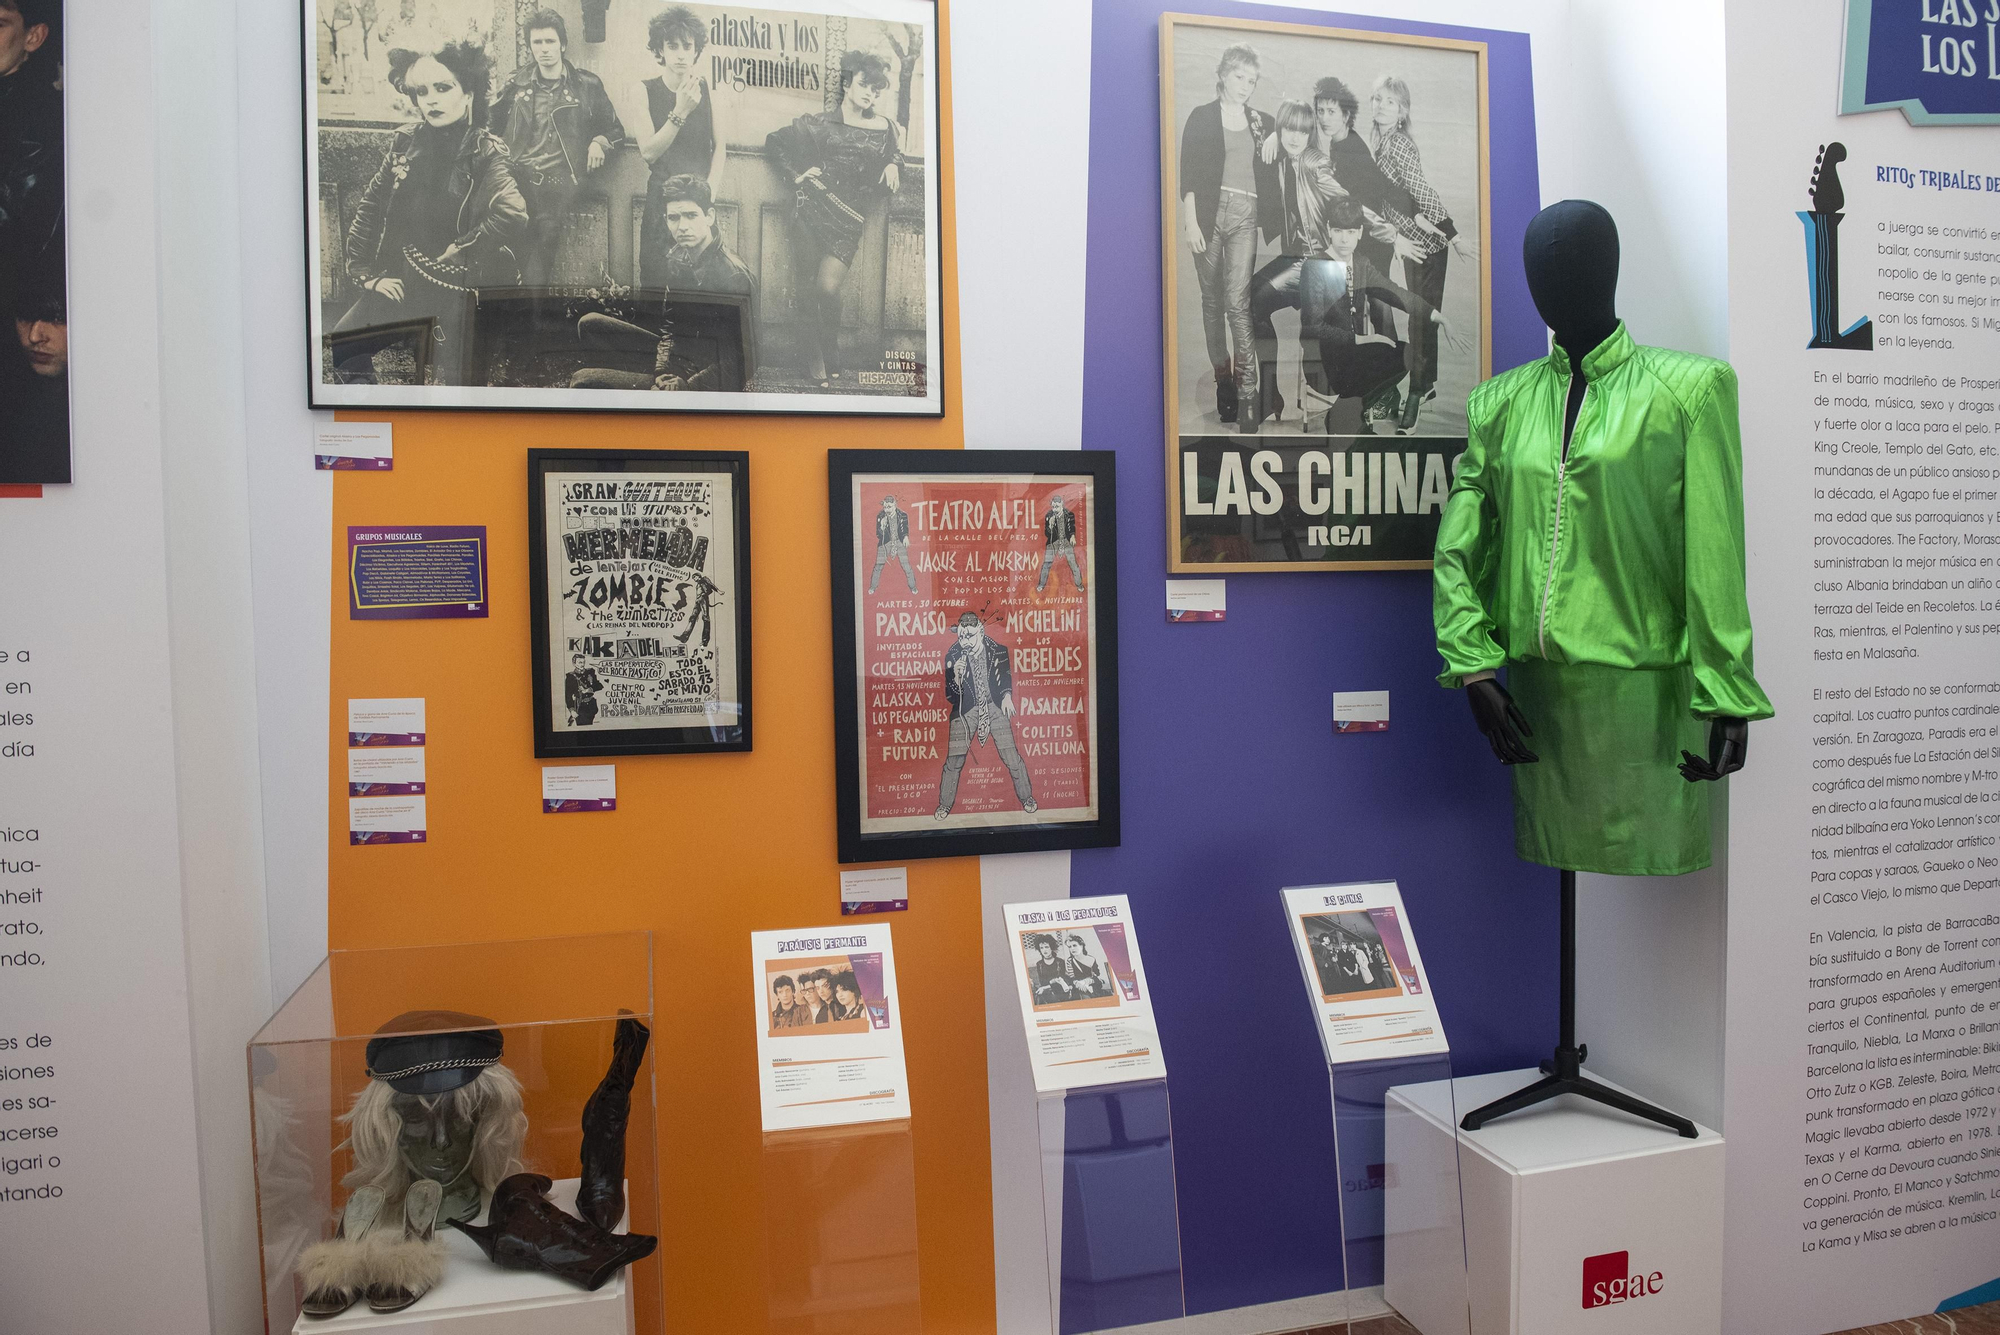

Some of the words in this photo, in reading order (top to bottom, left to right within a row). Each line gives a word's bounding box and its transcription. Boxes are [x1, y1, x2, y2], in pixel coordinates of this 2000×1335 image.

[711, 13, 772, 50] alaska
[777, 22, 787, 57] y
[794, 19, 819, 53] los
[1921, 34, 1977, 78] LOS
[711, 55, 820, 92] pegamoides
[1919, 169, 1981, 191] TRIBALES
[1877, 222, 1885, 232] a
[1888, 220, 1924, 237] juerga
[1927, 226, 1939, 236] se
[1942, 227, 1988, 240] convirtió
[1878, 337, 1893, 347] en
[1895, 336, 1905, 348] la
[1908, 337, 1955, 350] leyenda.
[885, 350, 916, 360] DISCOS
[880, 361, 885, 370] Y
[887, 361, 916, 370] CINTAS
[858, 371, 916, 385] HISPAVOX
[1814, 441, 1838, 456] King
[1841, 441, 1881, 455] Creole,
[1884, 442, 1924, 457] Templo
[1926, 443, 1944, 455] del
[1946, 443, 1976, 457] Gato,
[1979, 445, 2000, 457] etc.
[1183, 450, 1284, 516] LAS
[1298, 450, 1463, 516] CHINA
[572, 482, 616, 500] GRAN
[1813, 487, 1825, 500] la
[1827, 486, 1876, 501] década,
[1879, 487, 1889, 500] el
[1891, 487, 1930, 503] Agapo
[1932, 488, 1950, 501] fue
[1952, 488, 1962, 501] el
[1964, 488, 1998, 502] primer
[911, 500, 984, 531] TEATRO
[987, 499, 1040, 530] ALFIL
[355, 533, 383, 541] GRUPOS
[384, 532, 423, 541] MUSICALES
[1308, 525, 1371, 546] RCA
[569, 561, 594, 577] de
[916, 550, 957, 574] JAQUE
[965, 551, 983, 572] AL
[987, 550, 1040, 572] MUERMO
[942, 587, 948, 595] Y
[987, 586, 1003, 594] LOS
[919, 599, 931, 608] 30
[576, 607, 586, 621] &
[590, 610, 613, 621] the
[605, 621, 627, 629] REINAS
[876, 642, 923, 652] INVITADOS
[1036, 637, 1051, 646] LOS
[16, 650, 30, 663] a
[1013, 646, 1082, 673] REBELDES
[1814, 648, 1843, 661] fiesta
[1846, 650, 1860, 661] en
[1863, 646, 1920, 660] Malasaña.
[676, 657, 704, 669] TODO
[871, 659, 944, 677] CUCHARADA
[668, 667, 697, 679] ESTO,
[697, 665, 711, 675] EL
[698, 673, 714, 685] 13
[6, 681, 31, 694] en
[605, 690, 646, 699] CULTURAL
[611, 683, 645, 692] CENTRO
[667, 688, 679, 696] DE
[681, 684, 711, 696] MAYO
[1813, 688, 1822, 700] El
[1825, 687, 1851, 701] resto
[1854, 686, 1871, 699] del
[1874, 684, 1910, 698] Estado
[1913, 685, 1926, 696] no
[1929, 685, 1941, 695] se
[607, 697, 642, 705] JUVENIL
[872, 692, 923, 708] ALASKA
[925, 692, 935, 706] Y
[1020, 696, 1085, 716] PASARELA
[873, 711, 888, 725] LOS
[889, 708, 948, 724] PEGAMOIDES
[893, 726, 936, 744] RADIO
[1022, 725, 1074, 739] COLITIS
[2, 741, 34, 757] día
[882, 745, 939, 761] FUTURA
[1023, 740, 1086, 757] VASILONA
[1323, 895, 1337, 906] LAS
[1337, 893, 1364, 906] CHINAS
[1018, 912, 1046, 924] ALASKA
[1047, 911, 1054, 921] Y
[1056, 910, 1071, 922] LOS
[1809, 932, 1823, 944] En
[1827, 927, 1878, 942] Valencia,
[1882, 925, 1893, 937] la
[1897, 922, 1923, 938] pista
[1926, 920, 1942, 932] de
[824, 936, 867, 950] PERMANTE
[26, 1033, 52, 1048] de
[29, 1097, 56, 1109] sa-
[49, 1156, 61, 1168] o
[1802, 1241, 1816, 1253] La
[1818, 1235, 1851, 1251] Kama
[1854, 1235, 1861, 1247] y
[1863, 1229, 1888, 1243] Misa
[1890, 1227, 1901, 1238] se
[1904, 1222, 1936, 1237] abren
[1939, 1219, 1946, 1230] a
[1949, 1216, 1959, 1228] la
[1961, 1210, 1997, 1227] música
[1592, 1270, 1664, 1307] sgae
